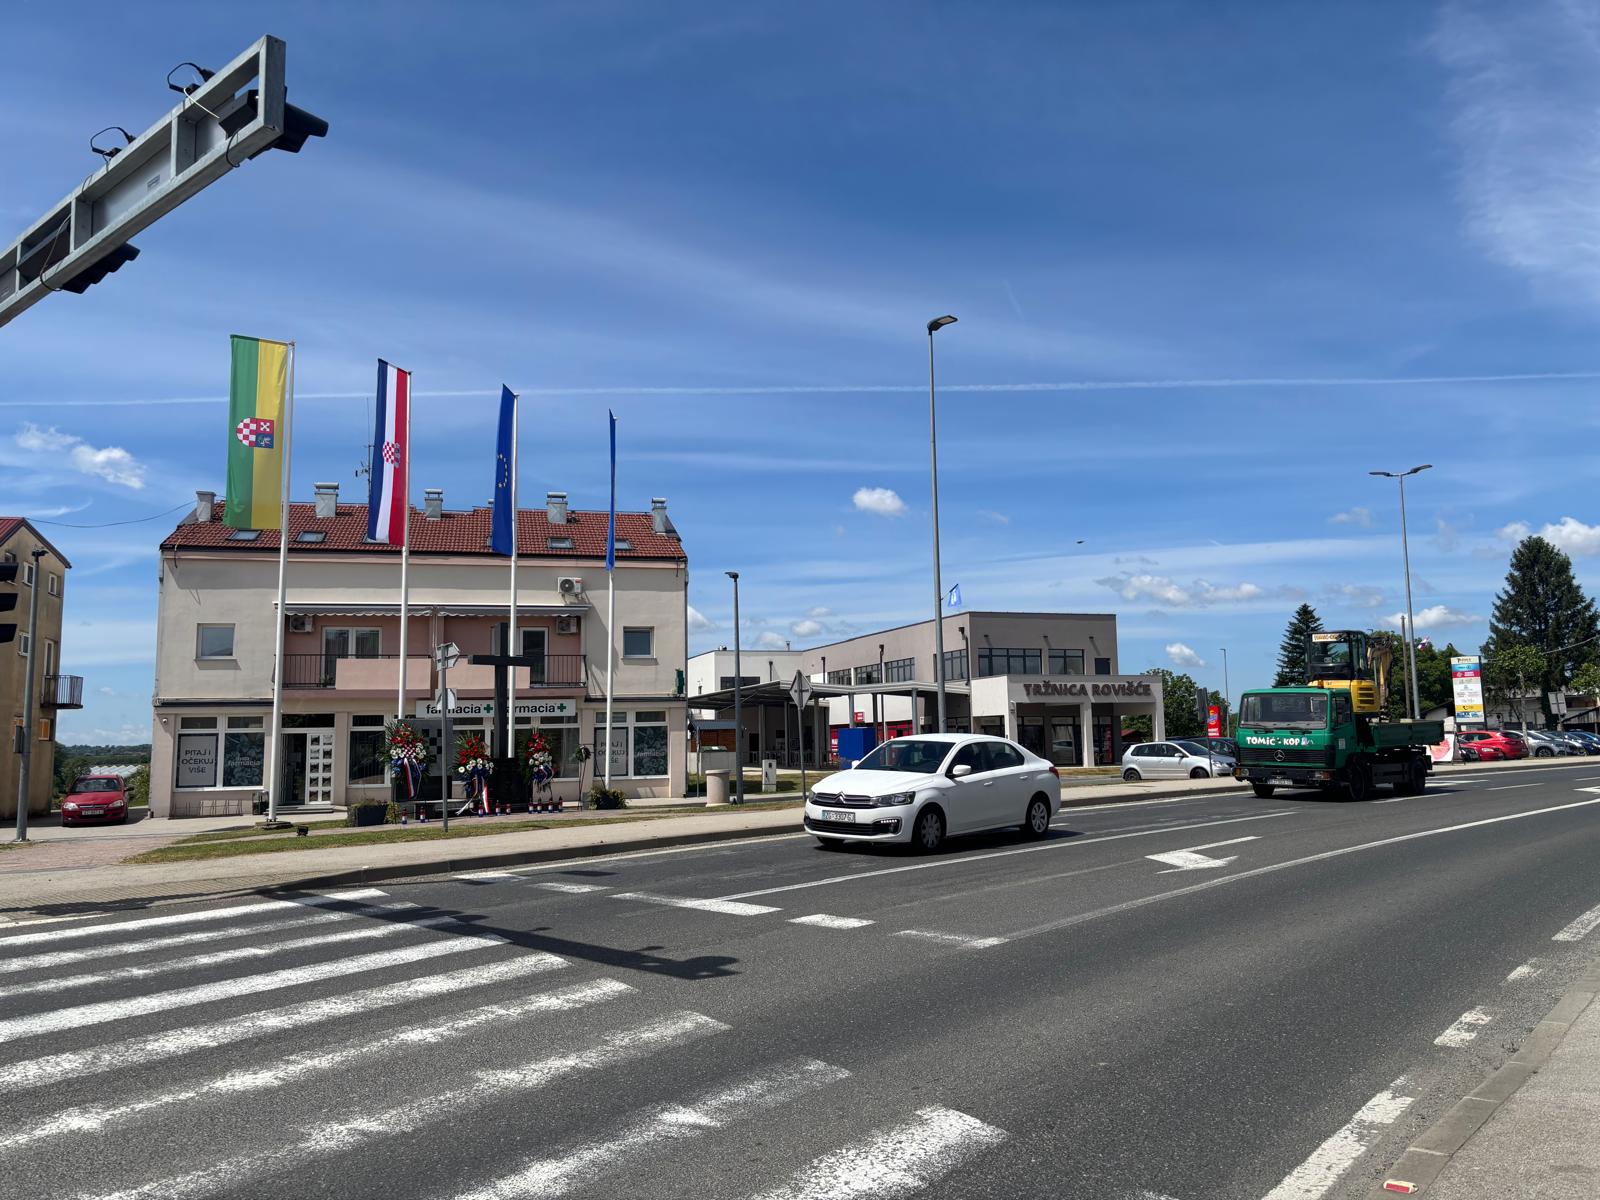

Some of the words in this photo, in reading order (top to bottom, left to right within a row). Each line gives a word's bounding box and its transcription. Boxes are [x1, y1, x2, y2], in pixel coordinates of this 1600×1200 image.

[1024, 680, 1088, 697] TRŽNICA
[1092, 680, 1152, 697] ROVIŠĆE
[426, 704, 481, 714] faacia
[1283, 737, 1300, 746] KOP
[182, 757, 214, 765] OČEKUJ
[189, 766, 207, 774] VIŠE
